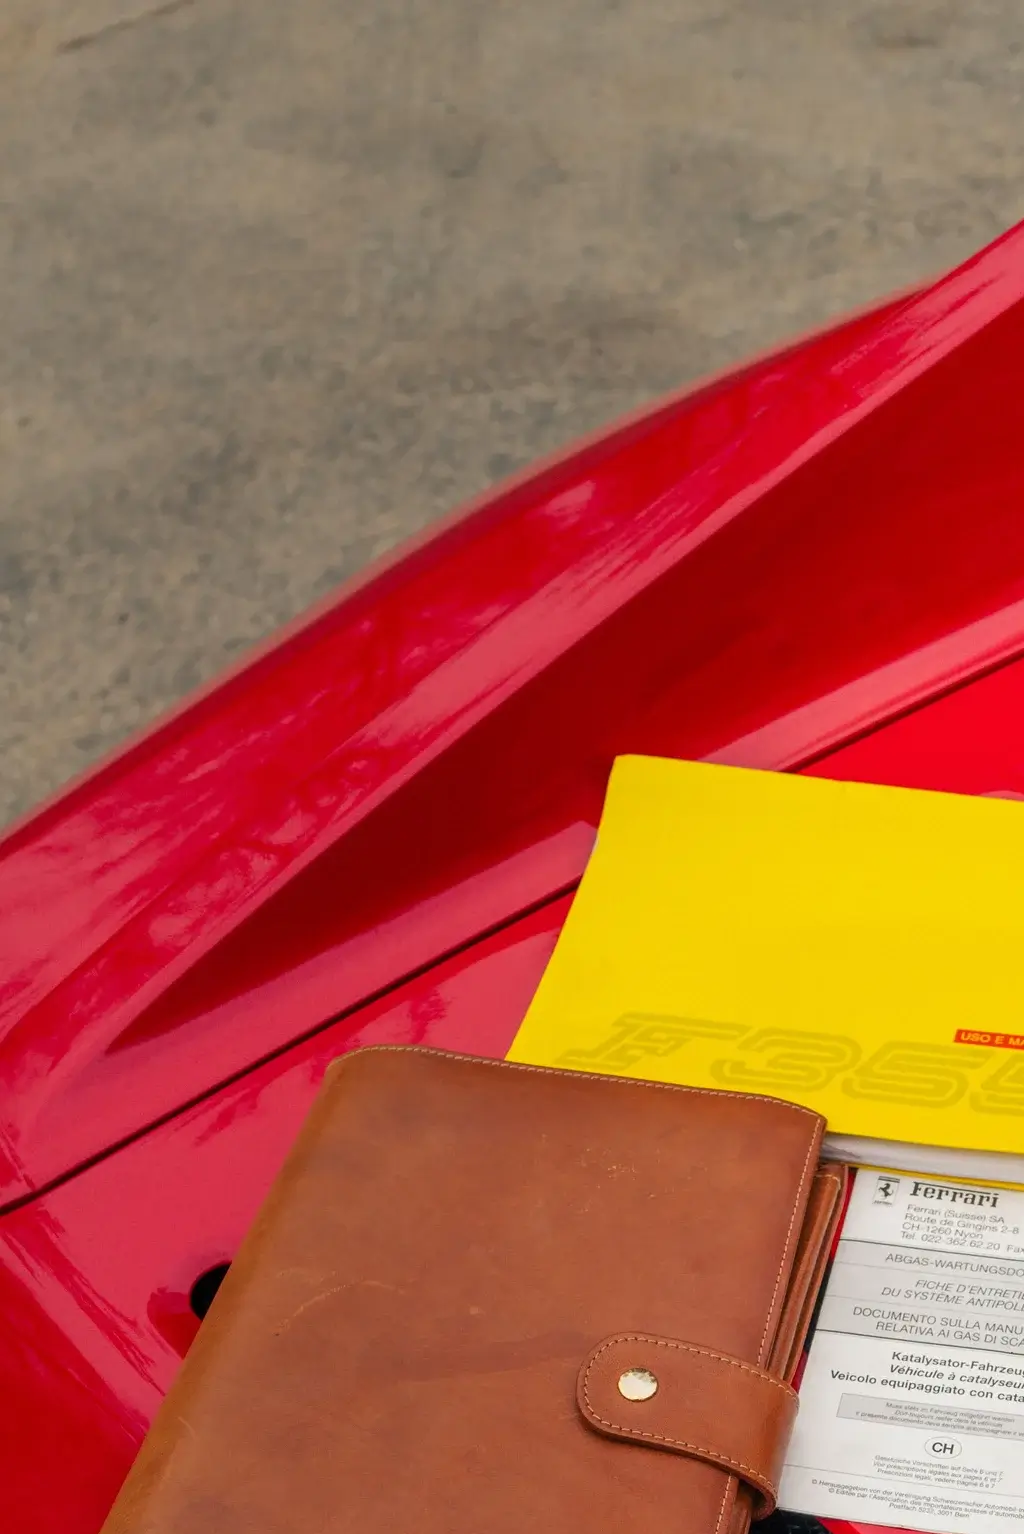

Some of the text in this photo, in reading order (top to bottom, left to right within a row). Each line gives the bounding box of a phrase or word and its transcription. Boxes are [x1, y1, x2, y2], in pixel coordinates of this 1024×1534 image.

[960, 1031, 991, 1043] USO
[995, 1036, 1005, 1045] E
[909, 1180, 1000, 1208] Ferrari
[880, 1286, 901, 1298] DU
[914, 1279, 953, 1292] FICHE
[851, 1306, 937, 1325] DOCUMENTO
[939, 1316, 981, 1330] SULLA
[875, 1320, 935, 1337] RELATIVA
[936, 1328, 950, 1338] AI
[952, 1329, 981, 1342] GAS
[983, 1333, 997, 1344] DI
[889, 1364, 945, 1380] Véhicule
[829, 1369, 878, 1384] Veicolo
[879, 1377, 966, 1397] equipaggiato
[968, 1388, 993, 1399] con
[930, 1441, 954, 1454] CH
